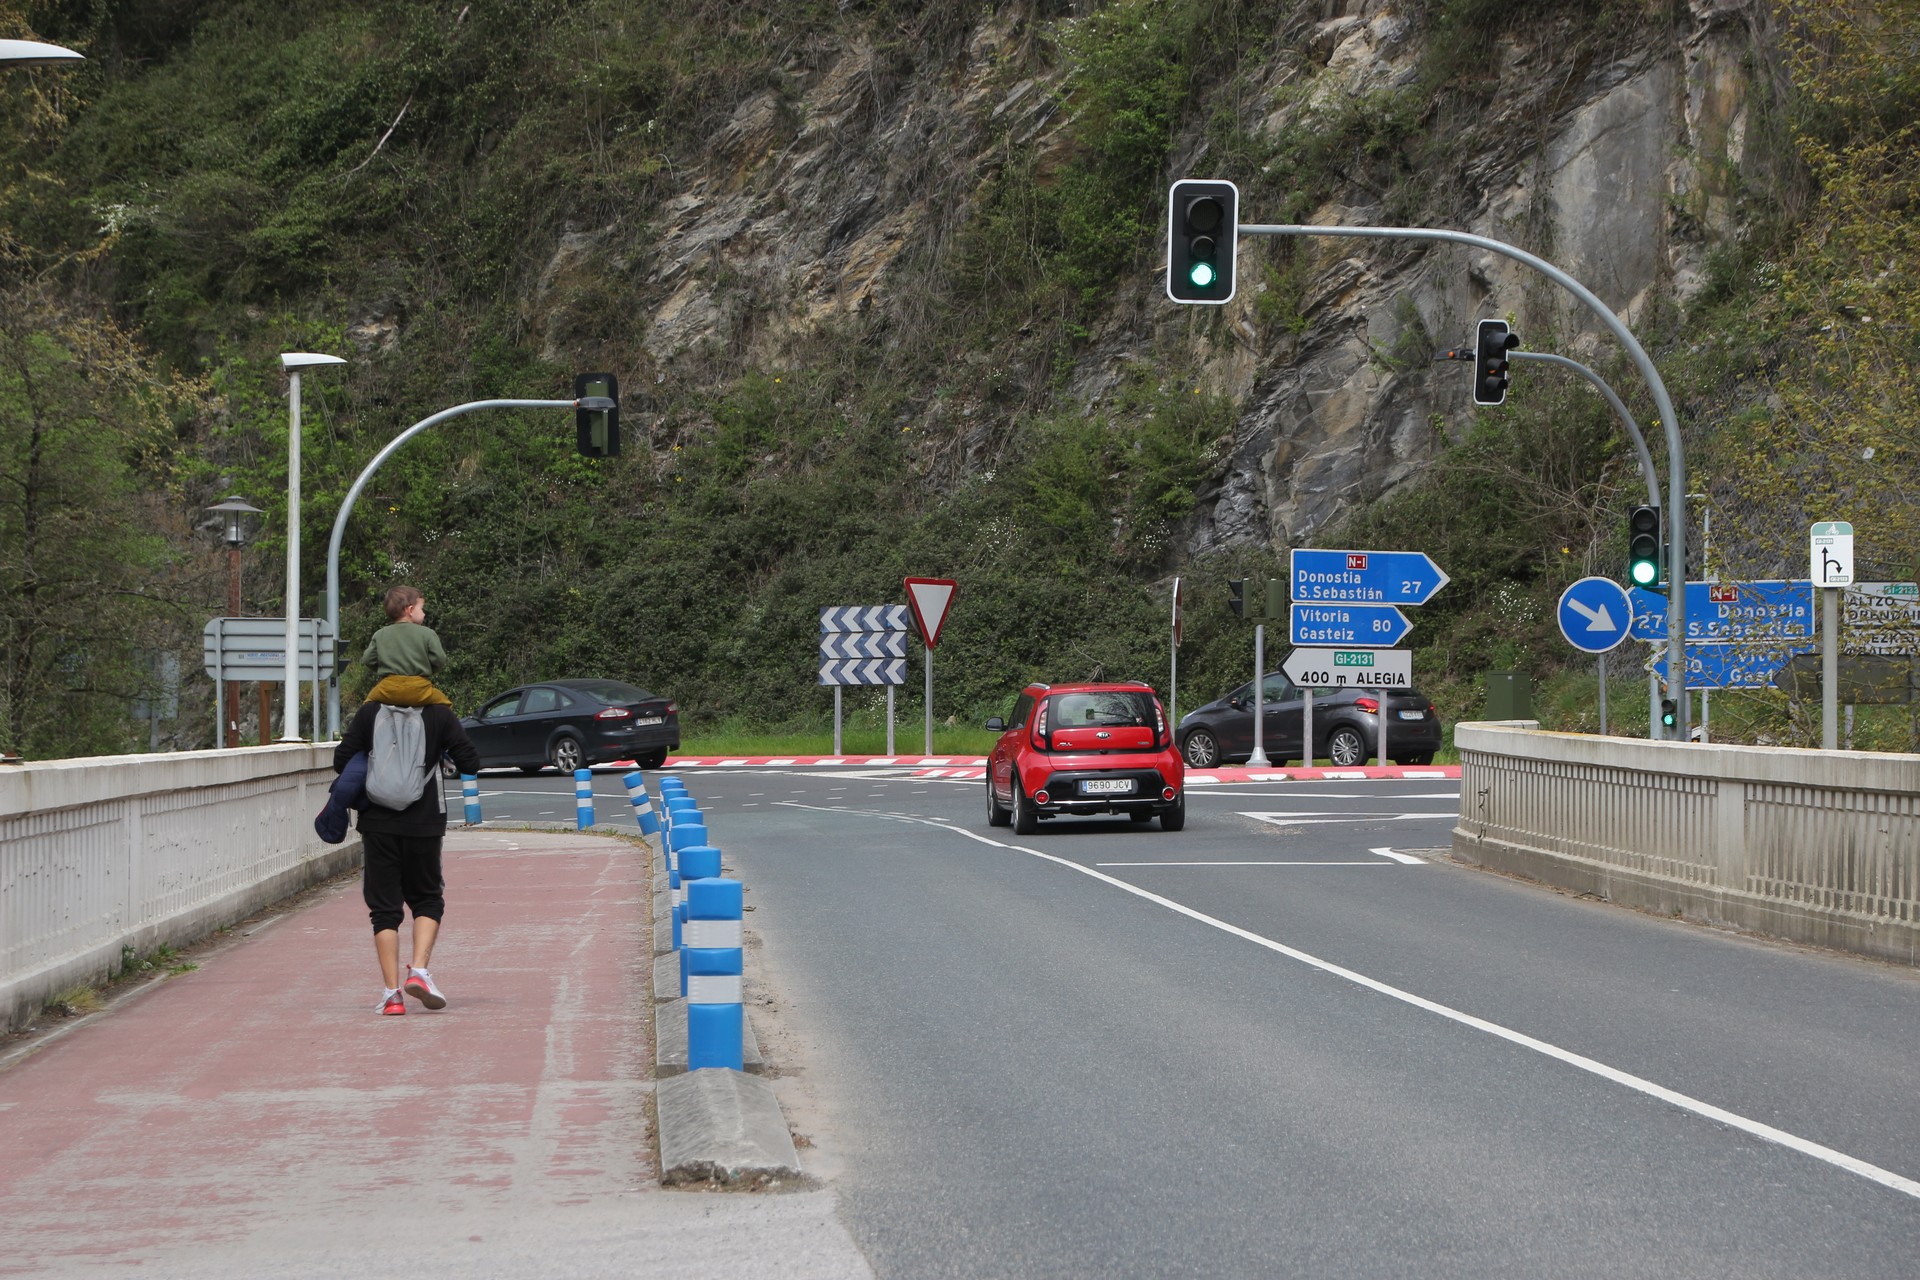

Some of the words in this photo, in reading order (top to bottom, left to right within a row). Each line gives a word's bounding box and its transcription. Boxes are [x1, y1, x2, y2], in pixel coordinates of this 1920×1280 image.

[1299, 570, 1362, 583] Donostia
[1299, 585, 1383, 600] S.Sebastián
[1401, 581, 1422, 594] 27
[1300, 609, 1350, 622] Vitoria
[1718, 604, 1805, 618] Donostia
[1372, 620, 1392, 632] 80
[1638, 615, 1663, 628] 27
[1300, 627, 1355, 640] Gasteiz
[1335, 653, 1373, 665] GI-2131
[1685, 660, 1702, 673] 0
[1301, 672, 1329, 683] 400
[1336, 675, 1347, 684] m
[1356, 673, 1405, 685] ALEGIA
[1088, 781, 1111, 789] 9690
[1113, 780, 1129, 788] JCV
